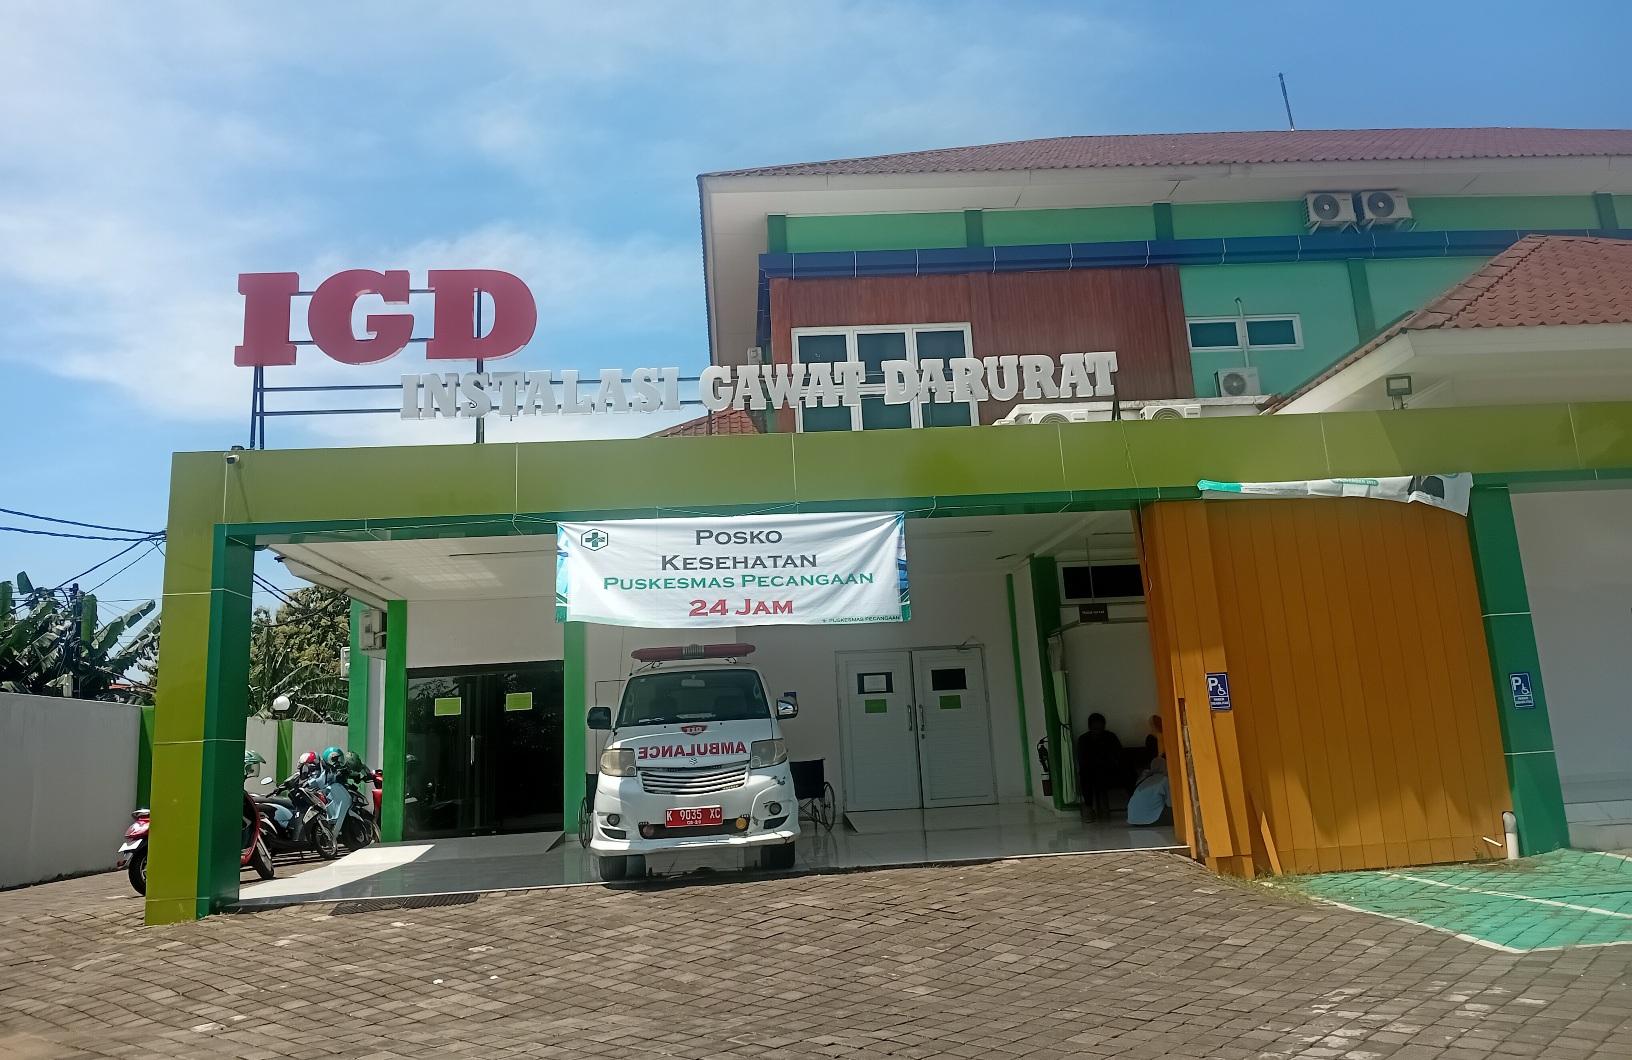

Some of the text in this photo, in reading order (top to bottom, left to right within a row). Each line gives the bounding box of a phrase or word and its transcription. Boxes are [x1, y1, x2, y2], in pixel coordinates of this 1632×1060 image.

[234, 269, 538, 367] IGD
[400, 351, 1118, 420] INSTALASI GAWAT DARURAT
[695, 529, 783, 546] POSKO
[661, 553, 817, 571] KESEHATAN
[603, 572, 874, 590] PUSKESMAS PECANGAAN
[689, 598, 793, 617] 24 JAM
[1208, 677, 1219, 691] P
[1511, 676, 1522, 691] P
[666, 808, 721, 821] K 9035 XC
